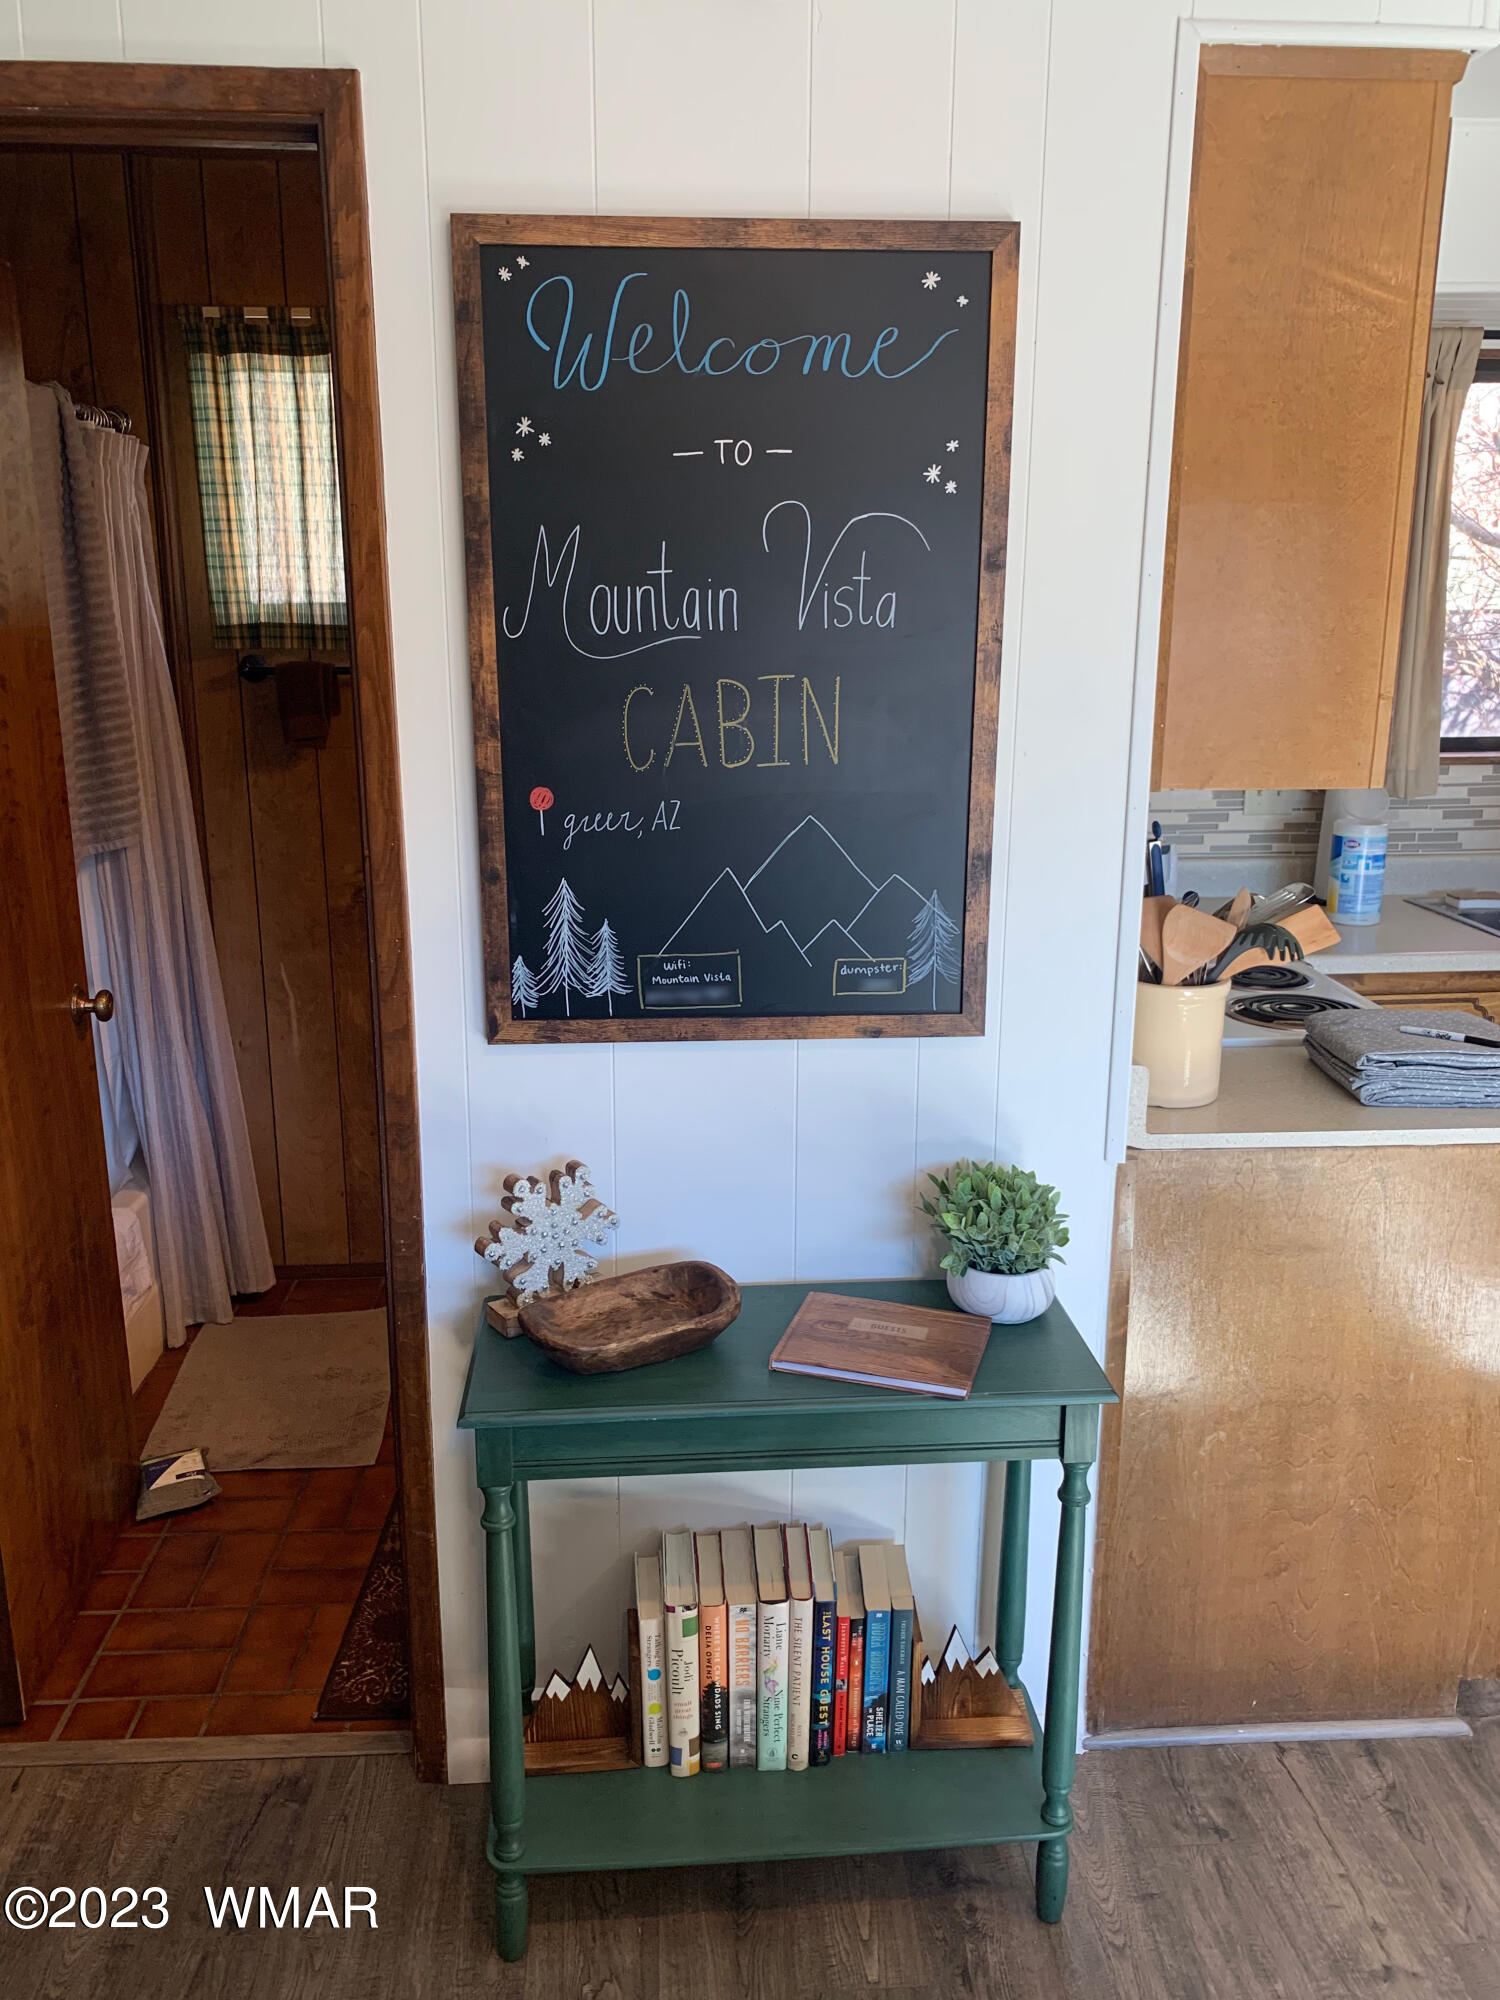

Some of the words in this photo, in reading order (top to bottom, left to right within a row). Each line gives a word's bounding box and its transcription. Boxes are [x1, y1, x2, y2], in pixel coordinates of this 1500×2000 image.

[526, 272, 960, 392] Welcome
[713, 439, 753, 466] TO
[503, 524, 739, 660] Mountain
[762, 500, 931, 631] Vista
[621, 674, 842, 773] CABIN
[562, 811, 645, 851] greer,
[651, 799, 682, 832] AZ
[652, 974, 700, 985] Mountain
[703, 972, 732, 983] Vista
[840, 963, 903, 977] dumpster:
[704, 1625, 712, 1649] DELIA
[713, 1616, 721, 1645] WHERE
[735, 1619, 751, 1633] NO
[763, 1616, 775, 1661] Moriarty
[775, 1622, 787, 1651] Liane
[793, 1617, 803, 1634] THE
[821, 1615, 832, 1642] LAST
[705, 1651, 713, 1680] OWENS
[735, 1637, 751, 1687] BARRIERS
[792, 1637, 803, 1668] SILENT
[820, 1646, 831, 1685] HOUSE
[671, 1649, 685, 1696] Picoult
[684, 1661, 694, 1682] Jodi
[895, 1677, 906, 1694] MAN
[714, 1665, 722, 1709] CRAWDADS
[773, 1688, 784, 1711] Nine
[791, 1670, 802, 1707] PATIENT
[760, 1696, 773, 1737] Strangers
[818, 1689, 830, 1726] GUEST
[875, 1706, 884, 1737] SHELTER
[895, 1695, 906, 1720] CALLED
[772, 1713, 784, 1742] Perfect
[866, 1714, 875, 1737] PLACE
[894, 1721, 905, 1735] OVE
